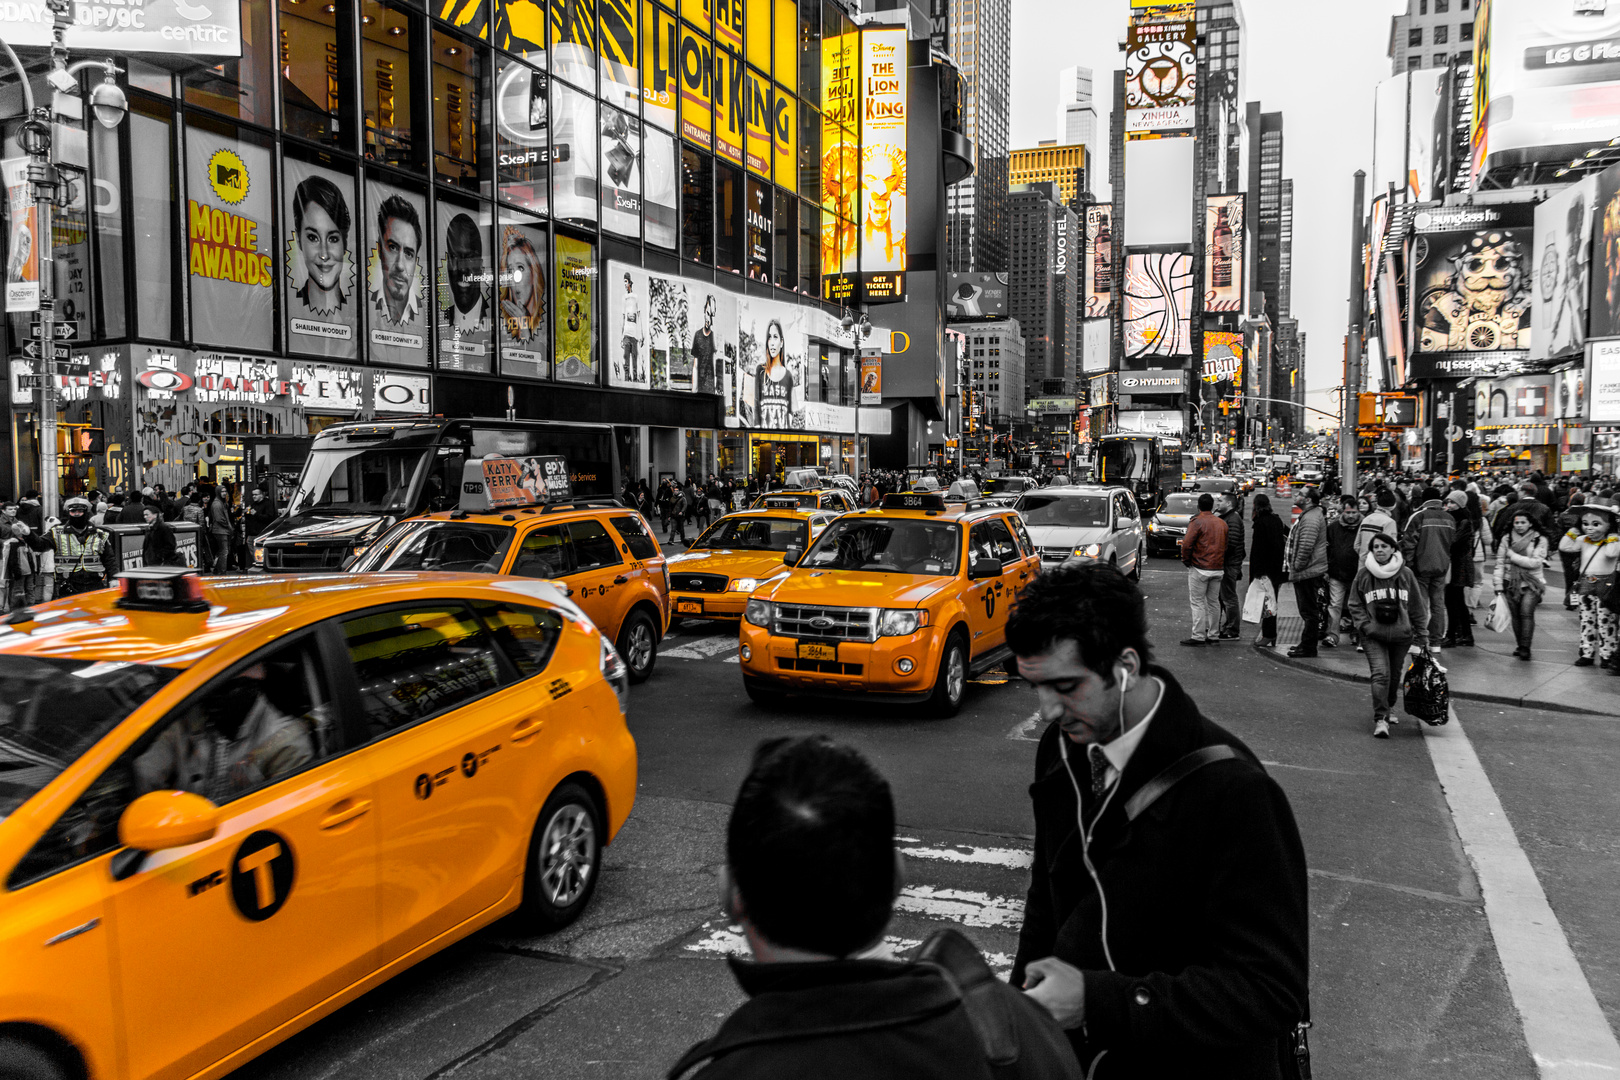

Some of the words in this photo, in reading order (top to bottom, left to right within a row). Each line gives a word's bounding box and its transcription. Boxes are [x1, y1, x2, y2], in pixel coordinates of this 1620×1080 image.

[160, 25, 228, 42] centric
[1164, 23, 1187, 33] XINHUA
[1137, 31, 1187, 43] GALLERY
[869, 43, 896, 53] Disney
[1545, 48, 1571, 64] LG
[1573, 44, 1591, 62] G
[653, 4, 723, 106] LION
[729, 43, 790, 145] KING
[872, 63, 894, 74] THE
[868, 77, 899, 96] LION
[866, 98, 903, 120] KING
[1142, 111, 1180, 121] XINHUA
[684, 122, 711, 143] ENTRANCE
[718, 140, 727, 151] ON
[729, 144, 741, 159] 45TH
[747, 155, 762, 170] STREET
[189, 200, 257, 251] MOVIE
[1433, 210, 1485, 227] sunglass
[1056, 215, 1067, 275] NOVOTEL
[189, 242, 272, 288] AWARDS
[561, 268, 587, 284] SUNDAY
[567, 299, 580, 332] 8
[56, 327, 71, 335] WAY
[295, 322, 320, 333] SHAILENE
[321, 325, 348, 336] WOODLEY
[375, 334, 392, 342] ROBERT
[392, 336, 412, 345] DOWNEY
[64, 364, 71, 375] 7
[201, 375, 306, 395] OAKLEY
[1140, 376, 1180, 392] HYUNDAI
[487, 463, 513, 475] KATY
[546, 459, 567, 475] epix
[485, 474, 518, 487] PERRY
[549, 480, 568, 489] MUSIC
[578, 473, 597, 482] Services
[465, 484, 483, 493] 7P19
[904, 497, 923, 506] 3B64
[238, 842, 282, 910] T
